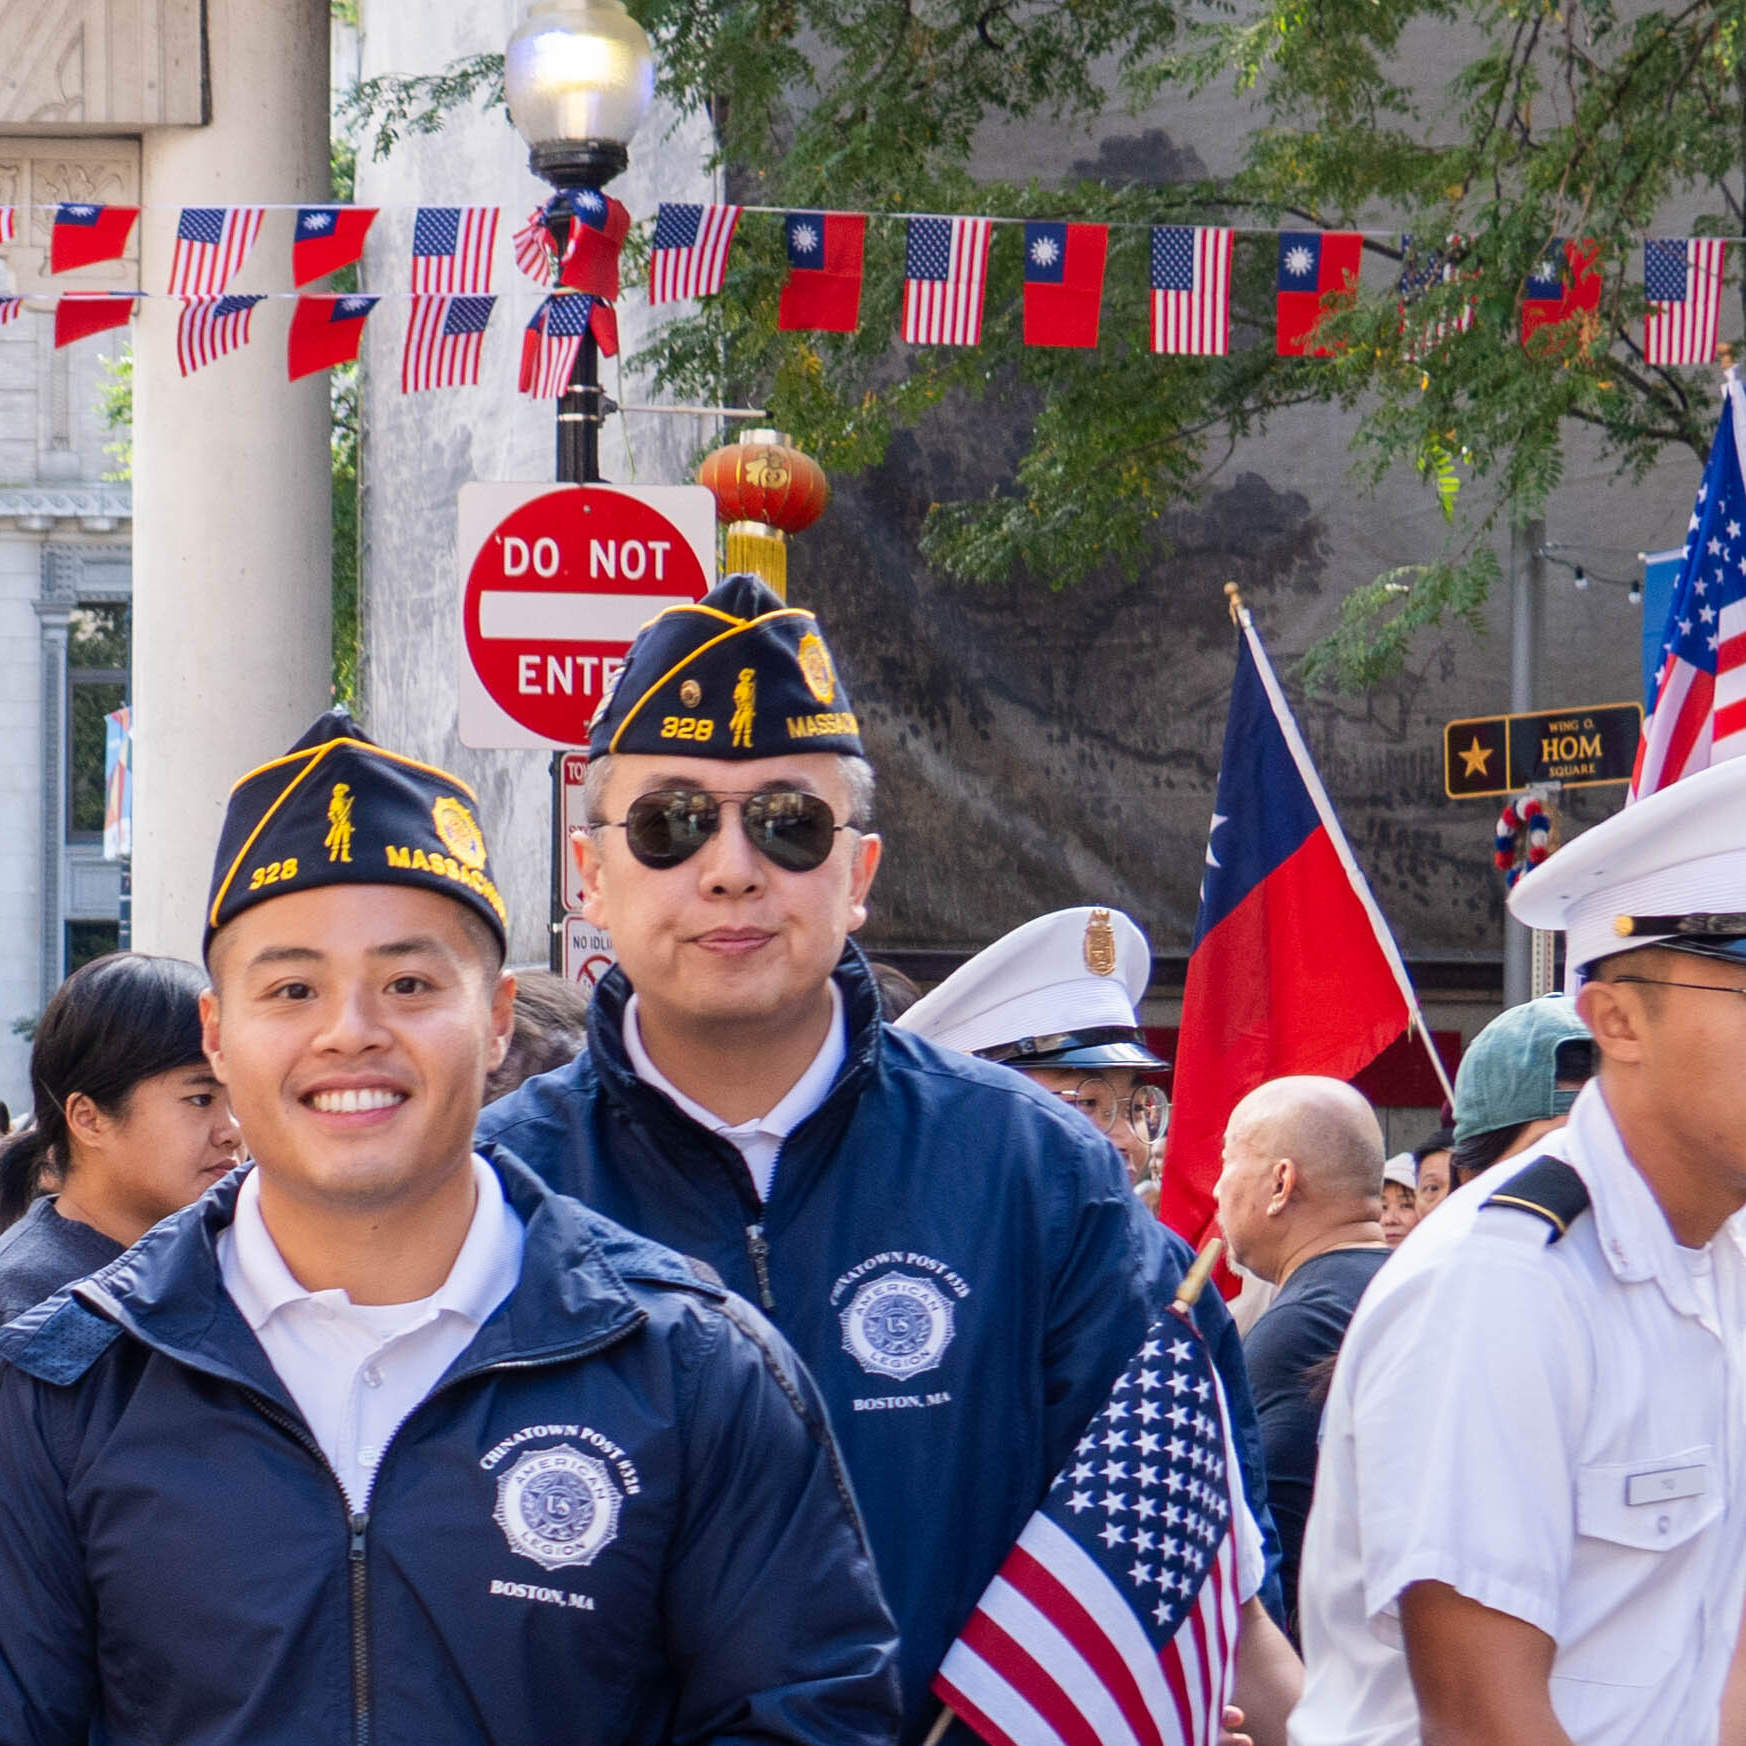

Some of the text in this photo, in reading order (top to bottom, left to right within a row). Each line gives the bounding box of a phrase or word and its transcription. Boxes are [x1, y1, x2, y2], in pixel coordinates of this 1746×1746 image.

[503, 536, 671, 580] DO NOT
[517, 654, 627, 696] ENTE
[660, 716, 714, 742] 328
[1549, 721, 1579, 733] WING
[1541, 734, 1603, 763] HOM
[1549, 763, 1596, 778] SQUARE
[248, 858, 299, 891] 328
[573, 936, 587, 950] NO
[906, 1252, 949, 1275] POST
[856, 1283, 939, 1314] AMERICAN
[870, 1350, 930, 1368] LEGION
[925, 1391, 951, 1406] MA
[478, 1424, 579, 1471] CHINATOWN
[579, 1428, 627, 1460] POST
[515, 1456, 606, 1501] AMERICAN
[520, 1530, 587, 1556] LEGION
[490, 1580, 595, 1611] BOSTON, MA
